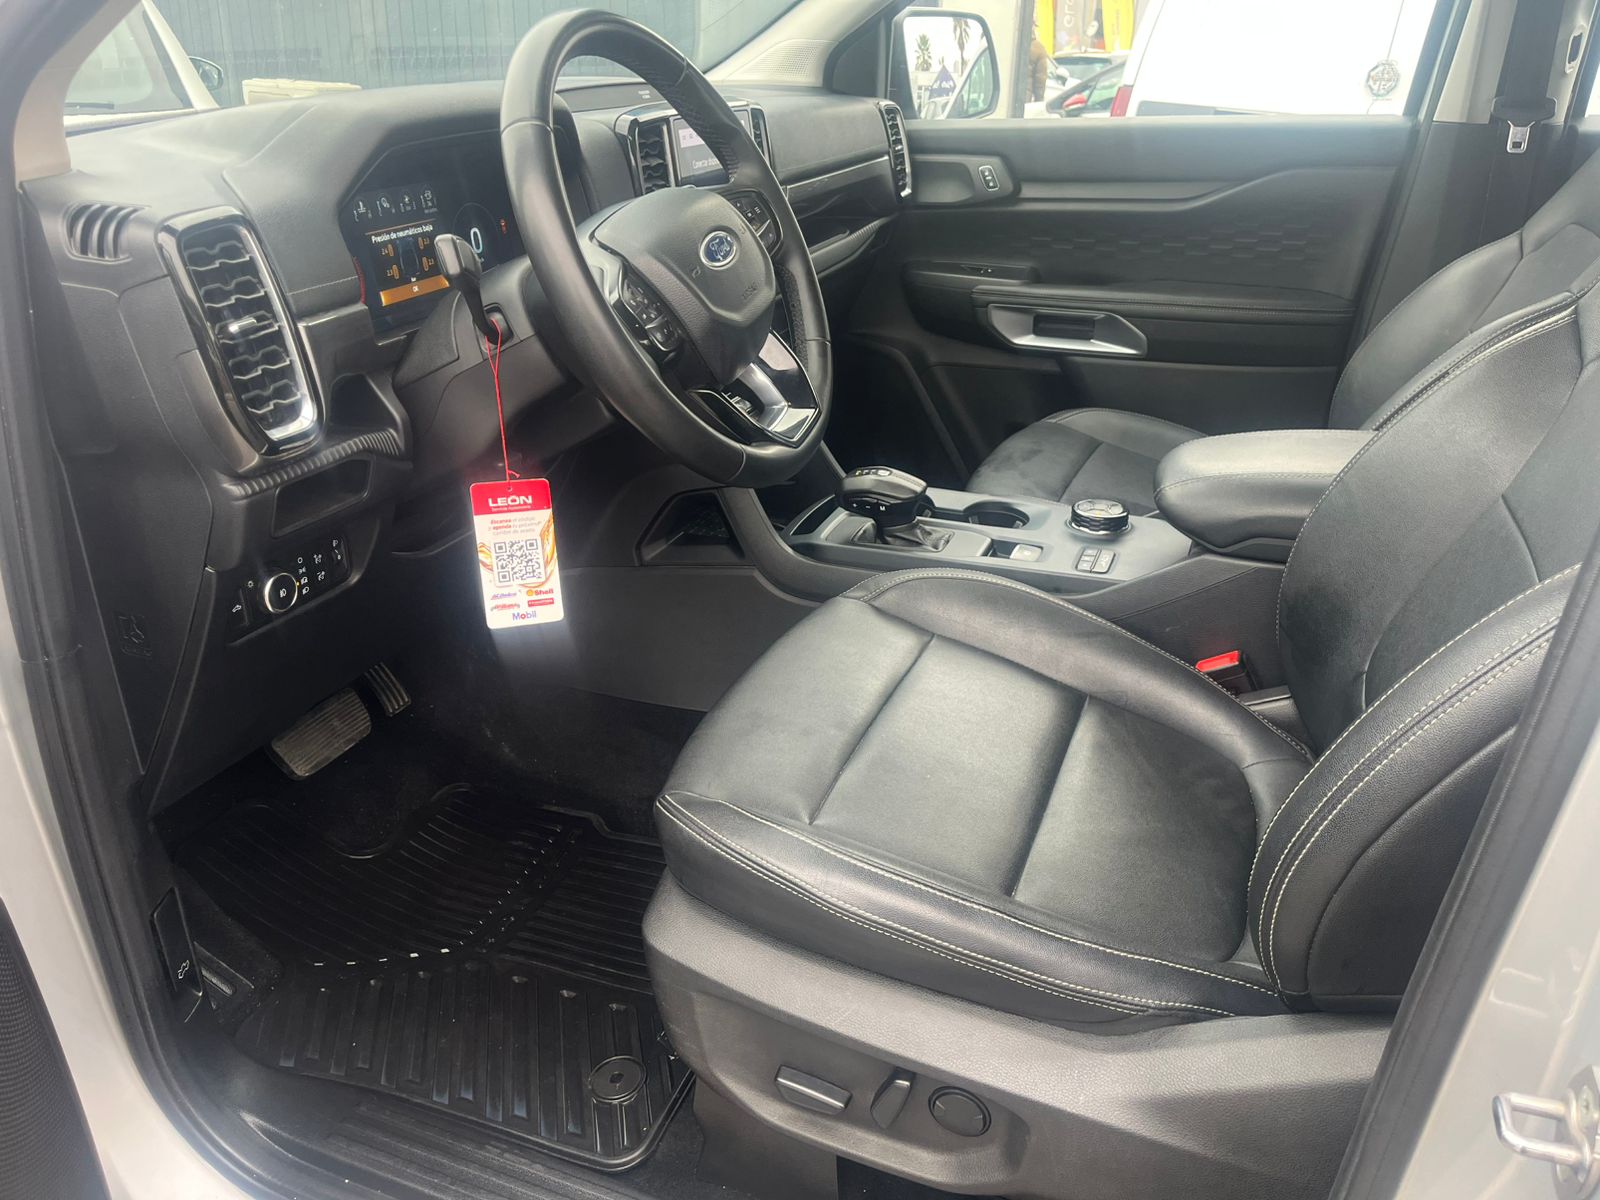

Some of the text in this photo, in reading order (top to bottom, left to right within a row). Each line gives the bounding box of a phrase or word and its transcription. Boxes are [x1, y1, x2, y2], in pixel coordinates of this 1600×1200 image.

[371, 224, 433, 244] Presión de neumáticos baja
[470, 227, 483, 253] 0
[709, 238, 732, 261] Ford
[534, 588, 554, 596] Shell
[512, 610, 537, 621] Mobil
